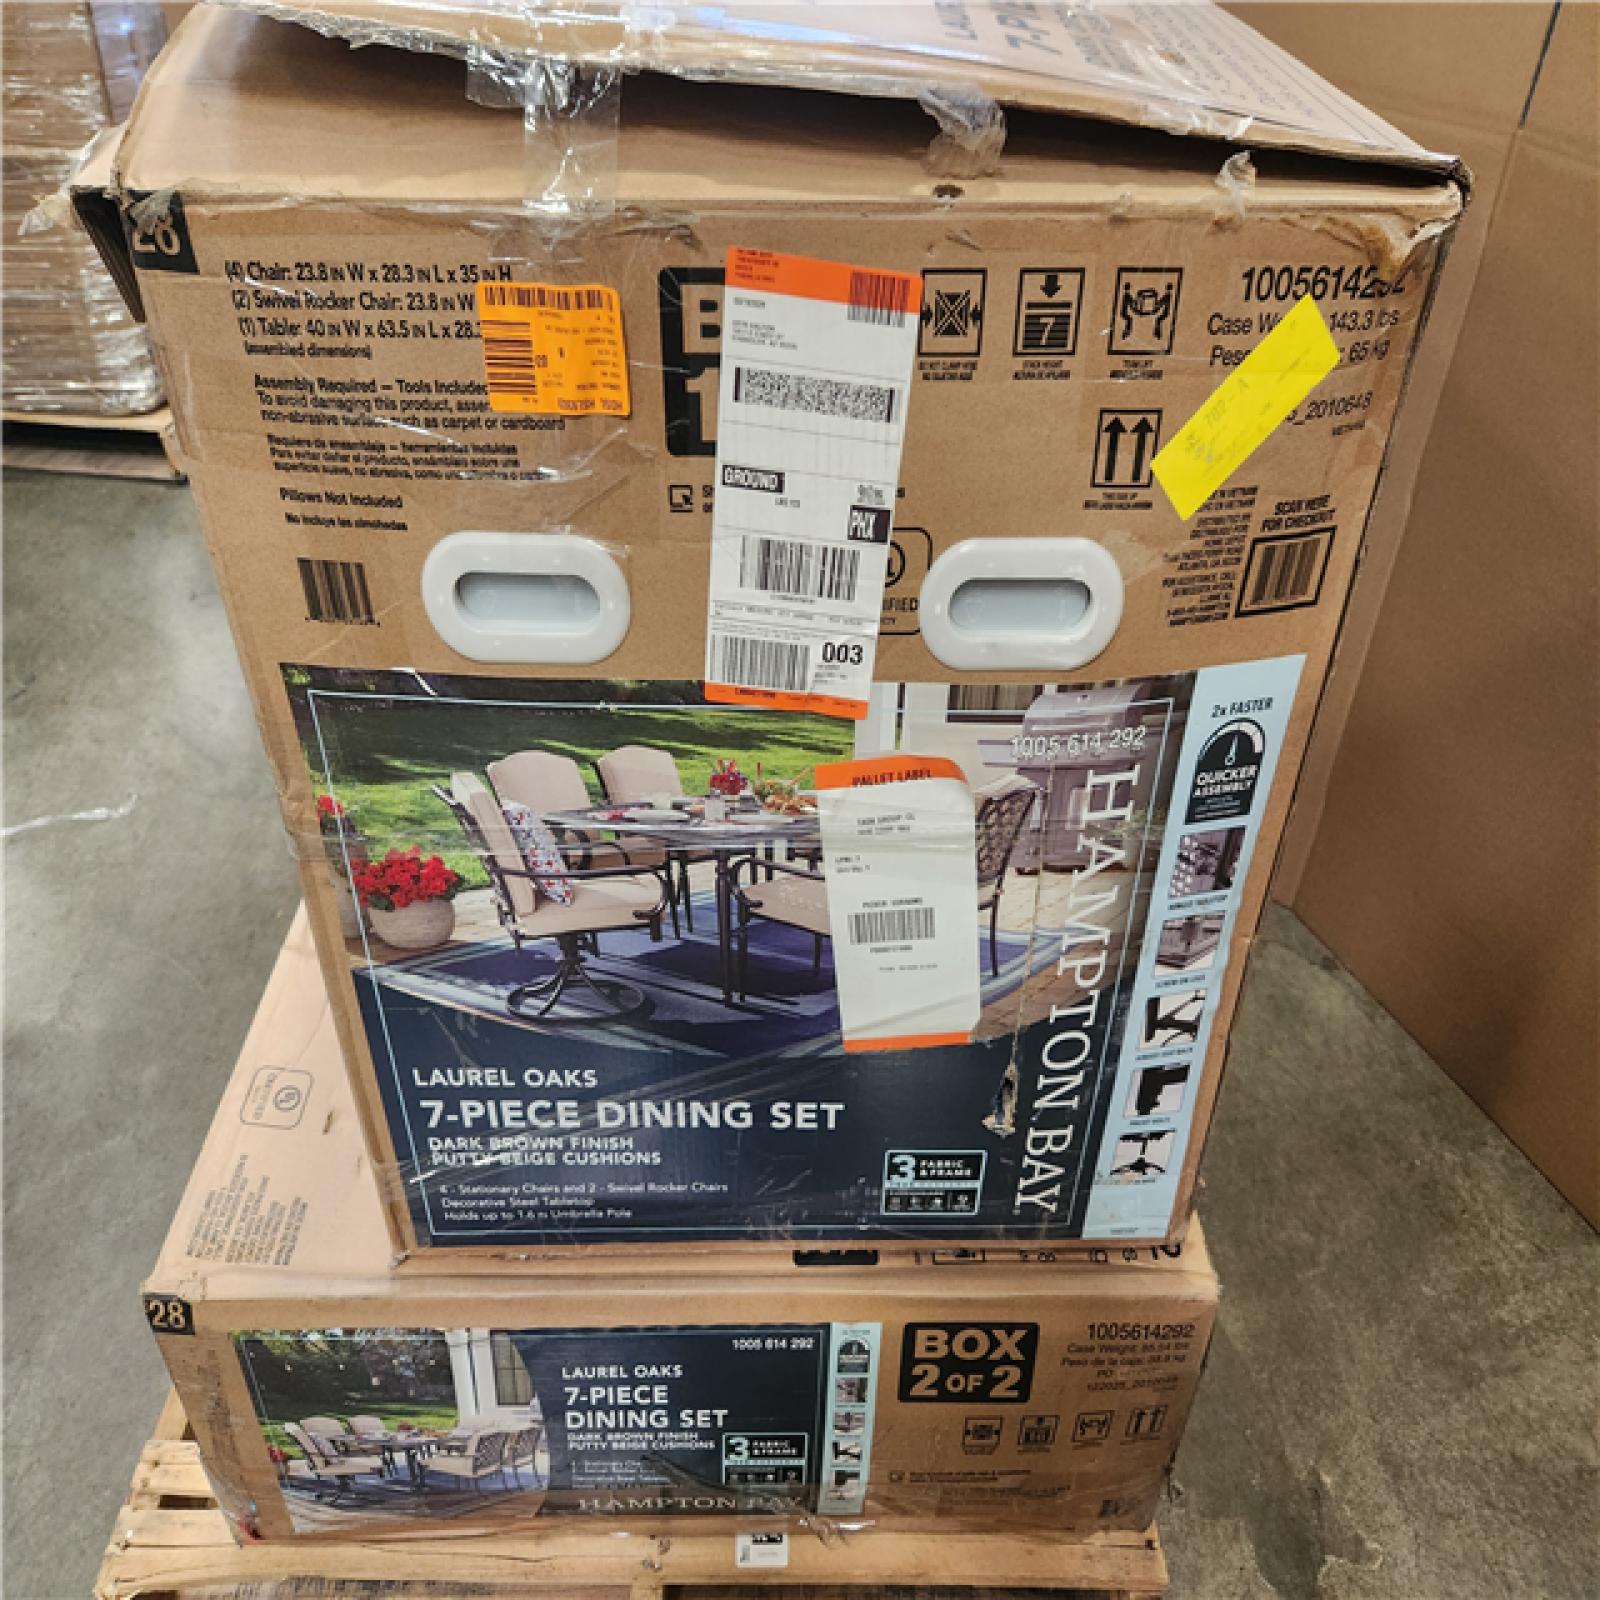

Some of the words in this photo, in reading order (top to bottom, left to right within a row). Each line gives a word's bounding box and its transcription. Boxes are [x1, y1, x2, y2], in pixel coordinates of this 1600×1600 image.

[295, 262, 327, 282] 23.8
[345, 262, 363, 282] W
[433, 264, 444, 283] L
[460, 264, 478, 283] 35
[497, 264, 511, 281] H
[406, 292, 438, 311] 23.8
[306, 319, 325, 337] 40
[343, 319, 361, 338] W
[428, 320, 439, 338] L
[1038, 316, 1056, 347] 7
[1207, 311, 1253, 336] Case
[823, 641, 863, 665] 003
[1229, 697, 1274, 716] FASTER
[1109, 724, 1147, 751] 292
[1033, 764, 1141, 1110] HAMPTON
[412, 1067, 516, 1089] LAUREL
[523, 1068, 599, 1089] OAKS
[419, 1099, 581, 1129] 7-PIECE
[597, 1100, 754, 1130] DINING
[768, 1101, 846, 1131] SET
[427, 1136, 484, 1151] DARK
[489, 1136, 564, 1151] BROWN
[570, 1136, 634, 1151] FINISH
[561, 1151, 662, 1167] CUSHIONS
[890, 1153, 916, 1186] 3
[1014, 1124, 1074, 1215] BAY
[521, 1182, 561, 1194] Chairs
[606, 1182, 645, 1193] Swivel
[647, 1182, 689, 1193] Rocker
[691, 1182, 729, 1193] Chairs
[147, 1299, 187, 1329] 28
[1086, 1322, 1195, 1341] 1005614292
[914, 1329, 1029, 1361] BOX
[561, 1365, 629, 1380] LAUREL
[634, 1364, 684, 1379] OAKS
[909, 1363, 941, 1397] 2
[945, 1373, 985, 1394] OF
[989, 1365, 1022, 1399] 2
[563, 1384, 670, 1406] 7-PIECE
[564, 1409, 670, 1429] DINING
[679, 1409, 729, 1429] SET
[728, 1436, 751, 1461] 3
